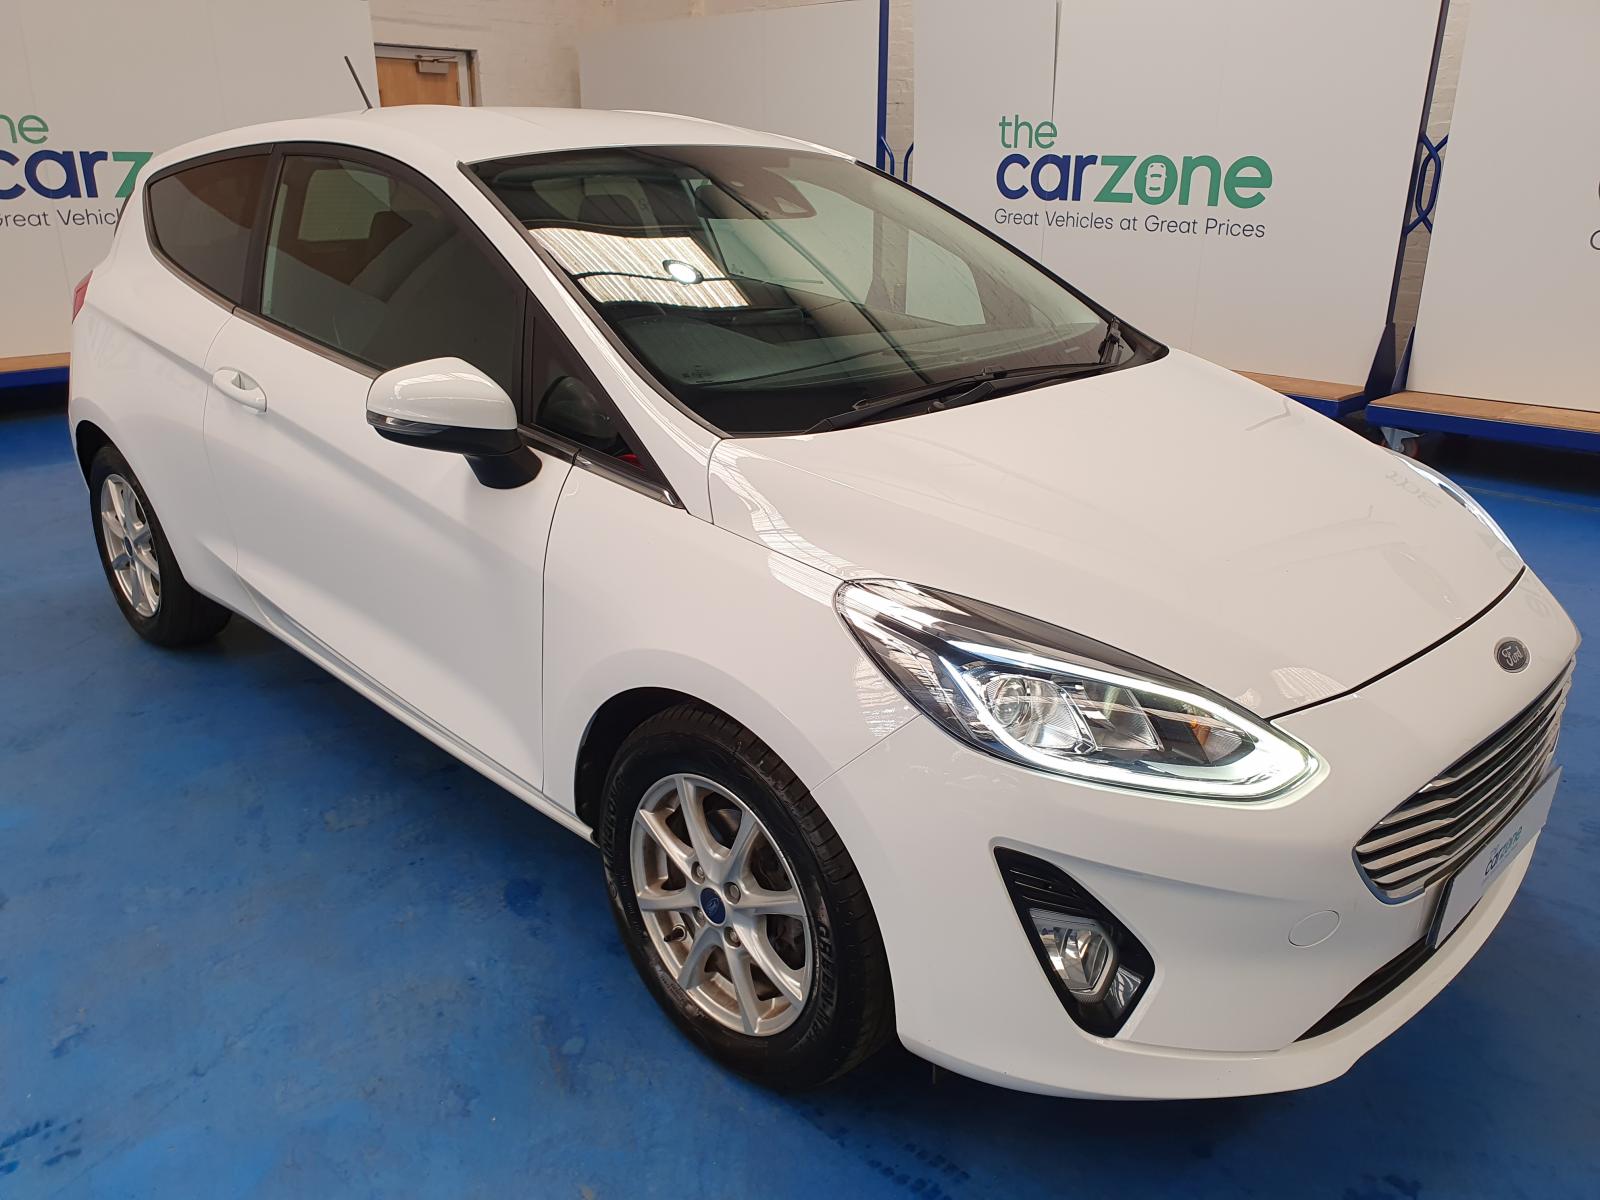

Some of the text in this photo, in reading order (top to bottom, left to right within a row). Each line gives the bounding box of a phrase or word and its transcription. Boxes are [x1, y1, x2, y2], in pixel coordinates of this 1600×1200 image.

[999, 114, 1058, 149] the
[996, 153, 1273, 209] carzone
[0, 211, 51, 227] reat
[994, 208, 1266, 238] Great Vehicles at Great Prices
